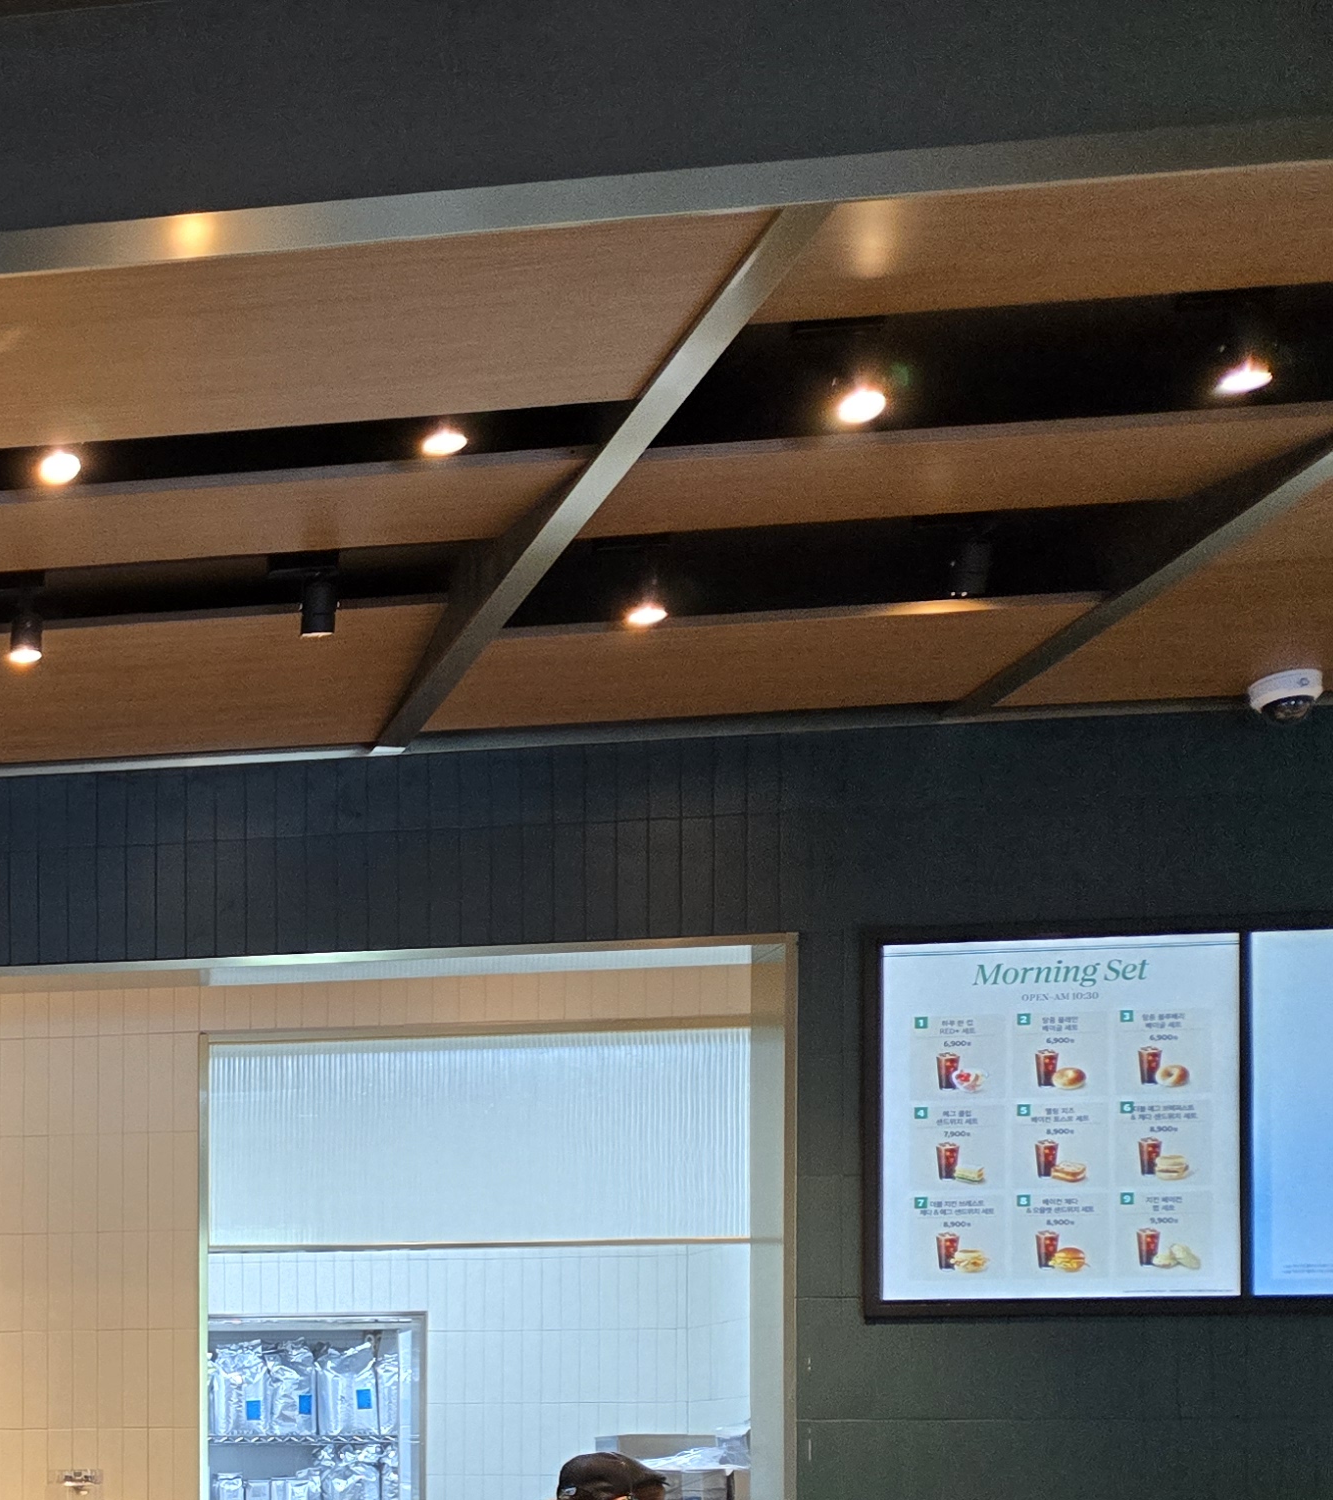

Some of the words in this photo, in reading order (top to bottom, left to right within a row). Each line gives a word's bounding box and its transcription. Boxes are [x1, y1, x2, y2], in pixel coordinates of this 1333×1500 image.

[973, 959, 1101, 987] Morning
[1104, 958, 1150, 982] Set
[1072, 991, 1099, 1000] 10:30
[1123, 1012, 1130, 1020] 3
[918, 1019, 924, 1027] 1
[918, 1199, 924, 1207] 7
[1020, 1197, 1027, 1205] 8
